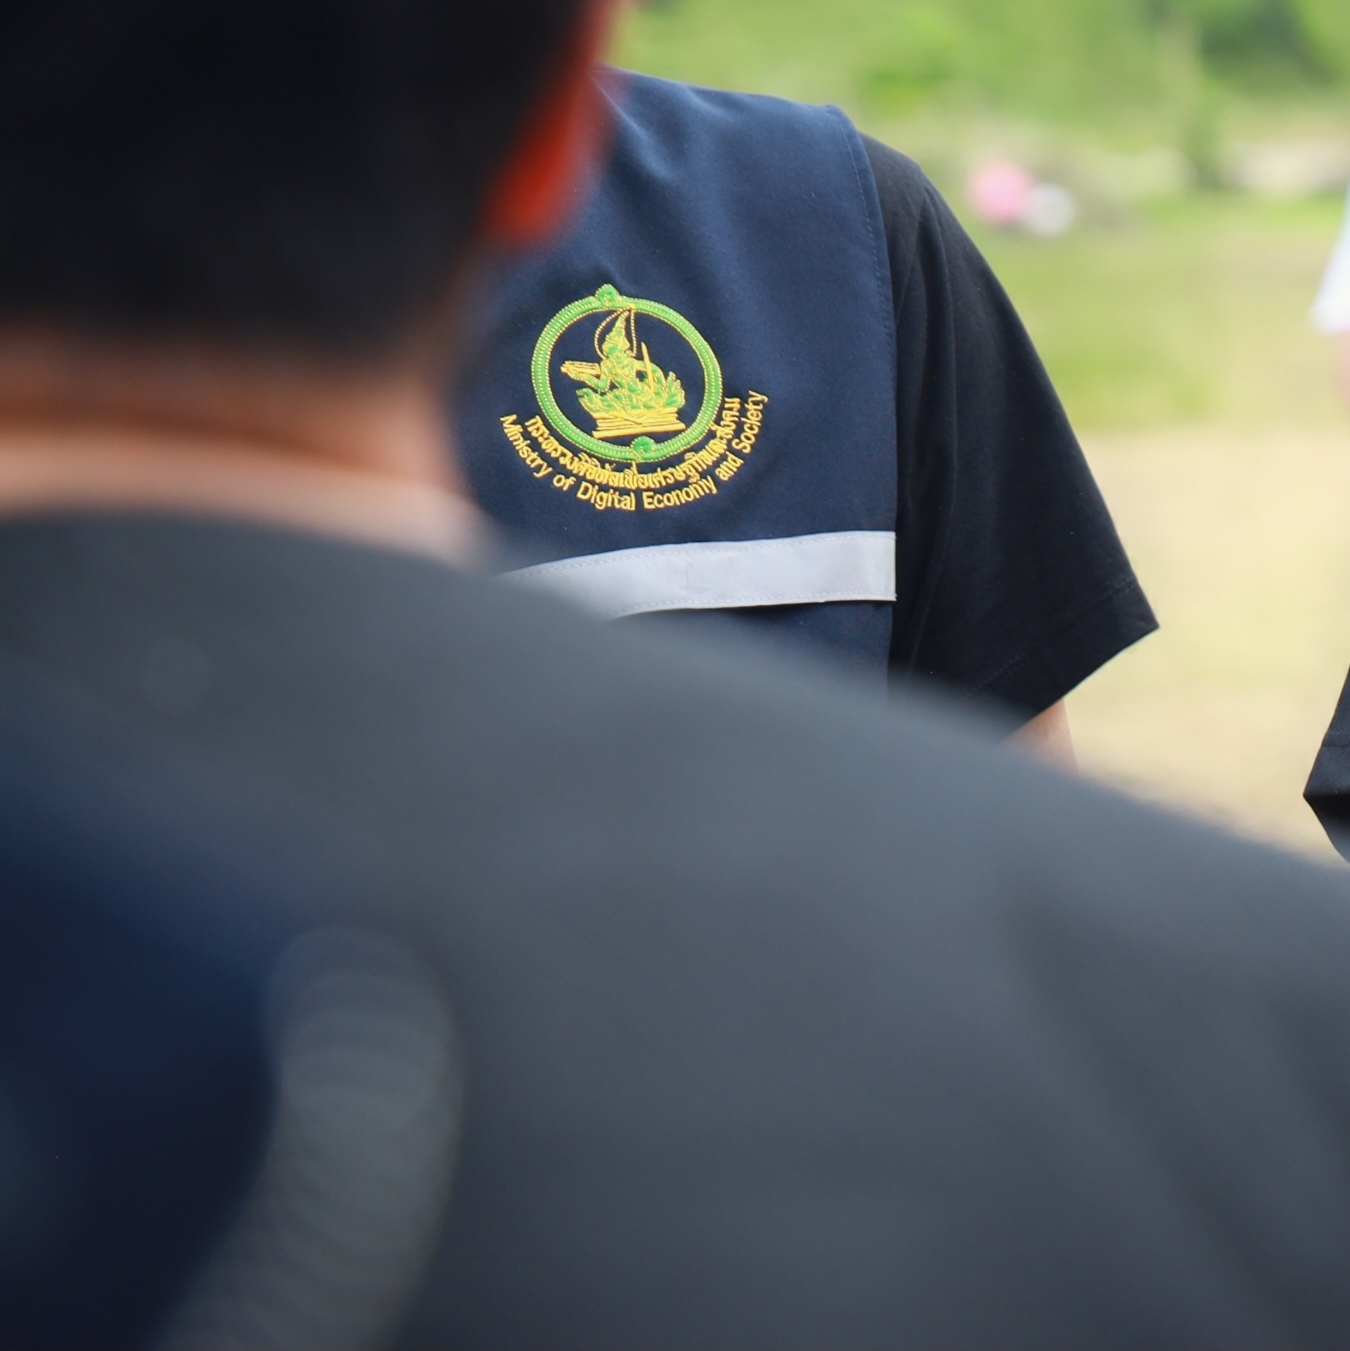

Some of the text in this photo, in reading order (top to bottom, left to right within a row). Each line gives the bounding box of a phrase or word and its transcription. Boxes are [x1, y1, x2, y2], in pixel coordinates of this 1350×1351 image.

[500, 390, 769, 511] Ministry of Digital Economy and Society
